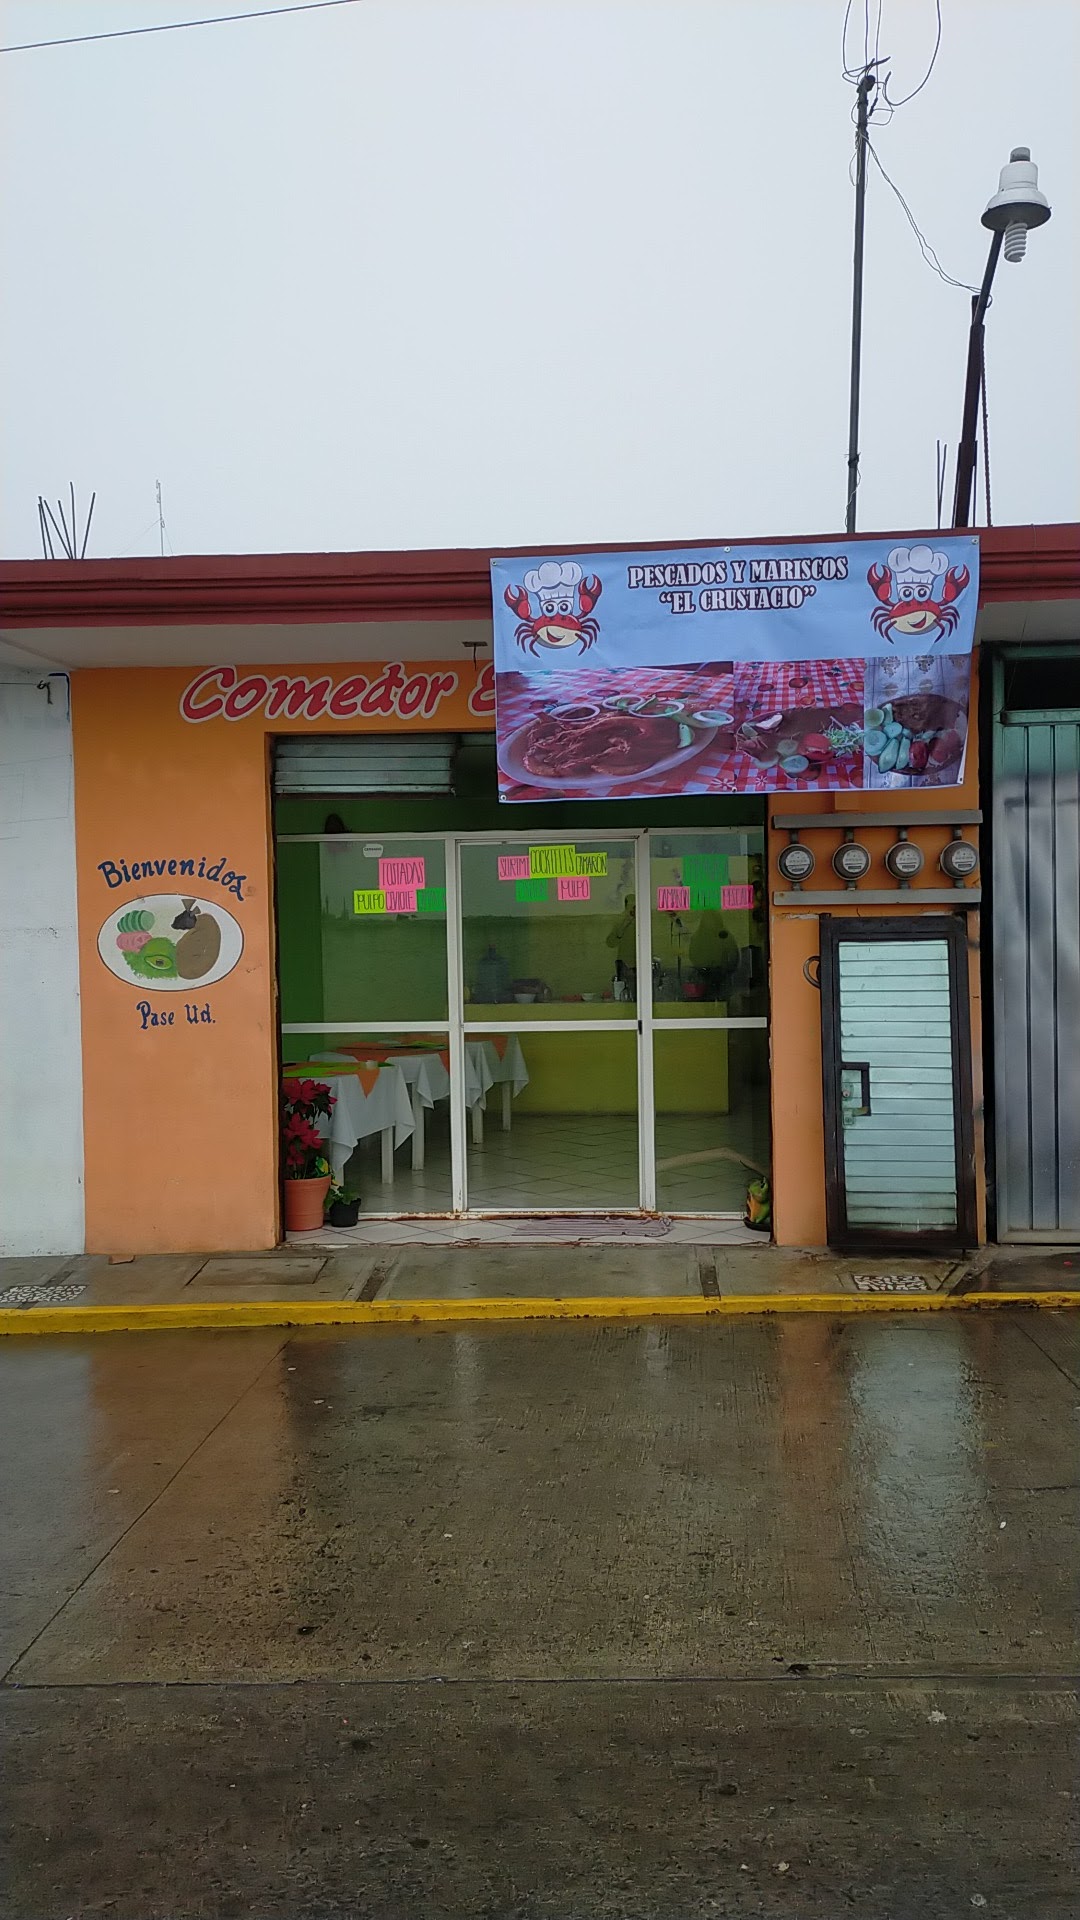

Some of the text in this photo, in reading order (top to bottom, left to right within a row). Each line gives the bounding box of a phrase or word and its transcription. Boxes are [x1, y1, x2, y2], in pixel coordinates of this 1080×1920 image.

[628, 556, 849, 588] PESCADOS Y MARISCOS
[180, 662, 459, 724] Comedor
[97, 856, 247, 901] Bienvenidos
[381, 861, 424, 886] TOSTADAS
[356, 893, 385, 911] PULPO
[136, 1001, 216, 1029] Pase Ud.
